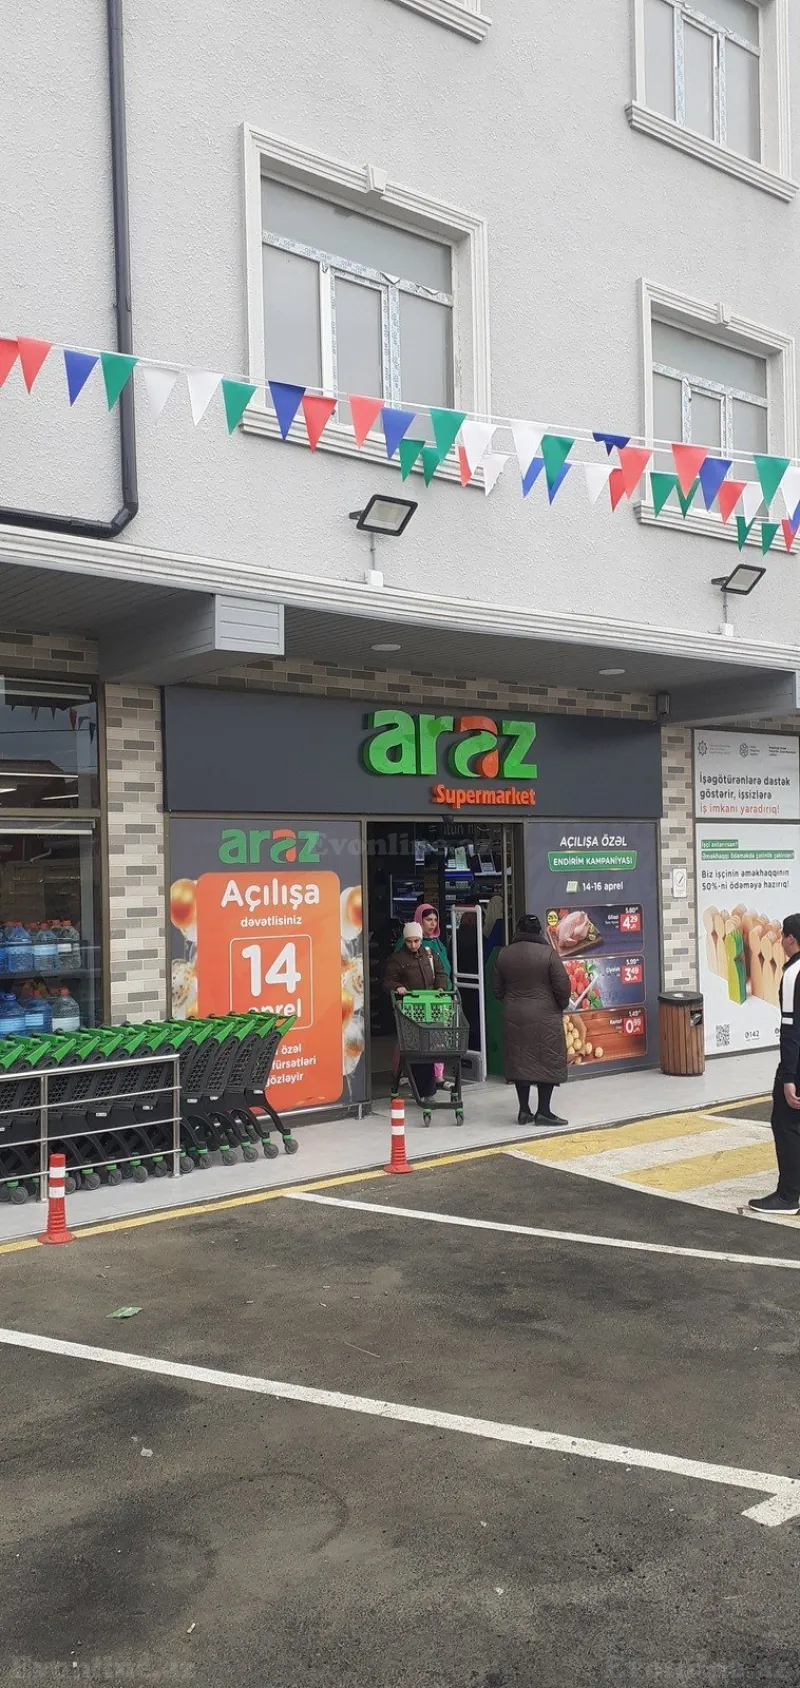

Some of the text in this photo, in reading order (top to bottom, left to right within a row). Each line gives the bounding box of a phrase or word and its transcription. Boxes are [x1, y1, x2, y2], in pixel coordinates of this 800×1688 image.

[364, 709, 538, 779] araz
[763, 776, 790, 786] dəstək
[433, 784, 536, 809] Supermarket
[218, 829, 321, 864] araz
[559, 833, 628, 849] AÇILIŞA ÖZƏL
[553, 855, 633, 866] ENDİRİM KAMPANİYASI
[702, 870, 713, 879] Biz
[582, 881, 624, 892] 14-16 aprel
[702, 881, 727, 891] 50%-ni
[220, 878, 320, 912] Açılışa
[240, 915, 303, 928] dəvətlisiniz
[241, 942, 302, 997] 14
[281, 1043, 302, 1055] özəl
